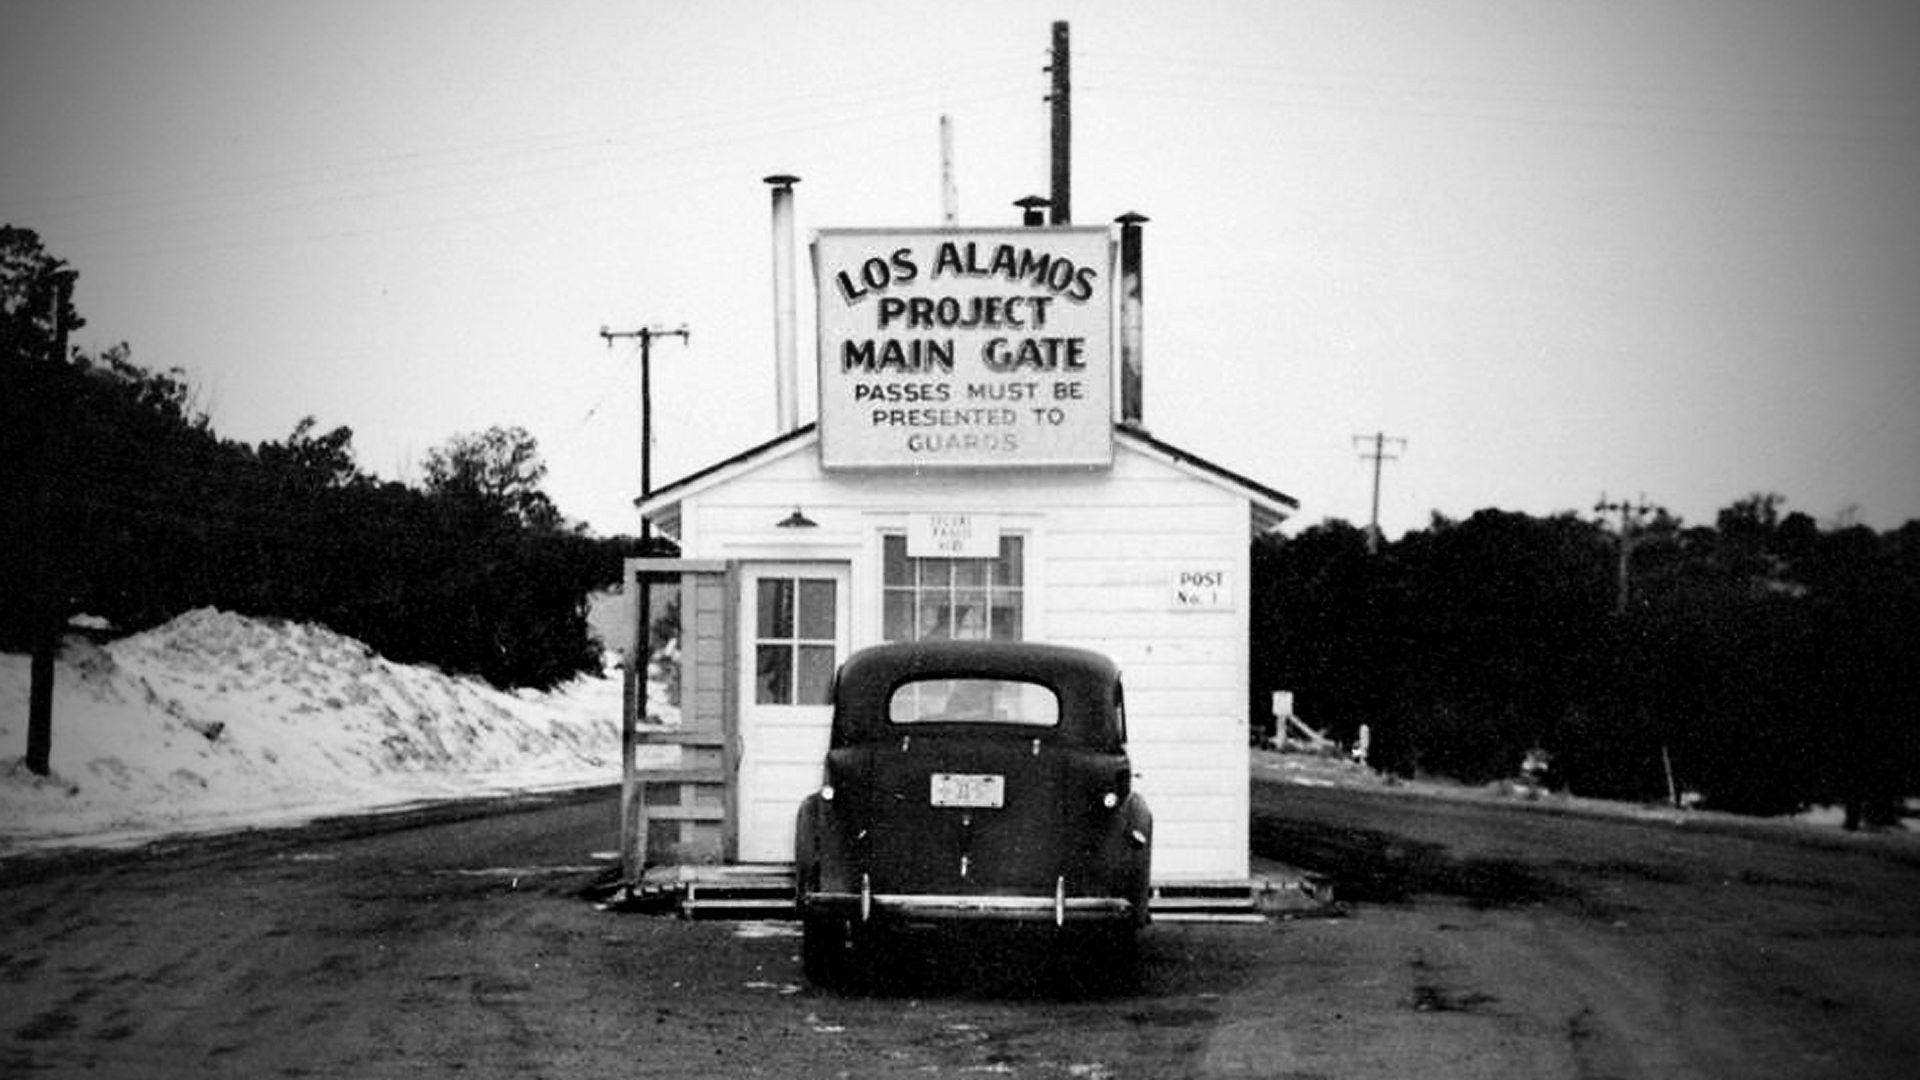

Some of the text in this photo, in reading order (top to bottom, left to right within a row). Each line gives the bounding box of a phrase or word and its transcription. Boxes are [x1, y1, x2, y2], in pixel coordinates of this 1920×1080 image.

[836, 242, 1097, 306] LOS ALAMOS
[877, 296, 1053, 330] PROJECT
[841, 337, 1087, 374] MAIN GATE
[855, 382, 1084, 402] PASSES MUST BE
[872, 408, 1065, 427] PRESENTED TO
[907, 434, 1019, 452] GUARDS
[1180, 572, 1222, 587] POST
